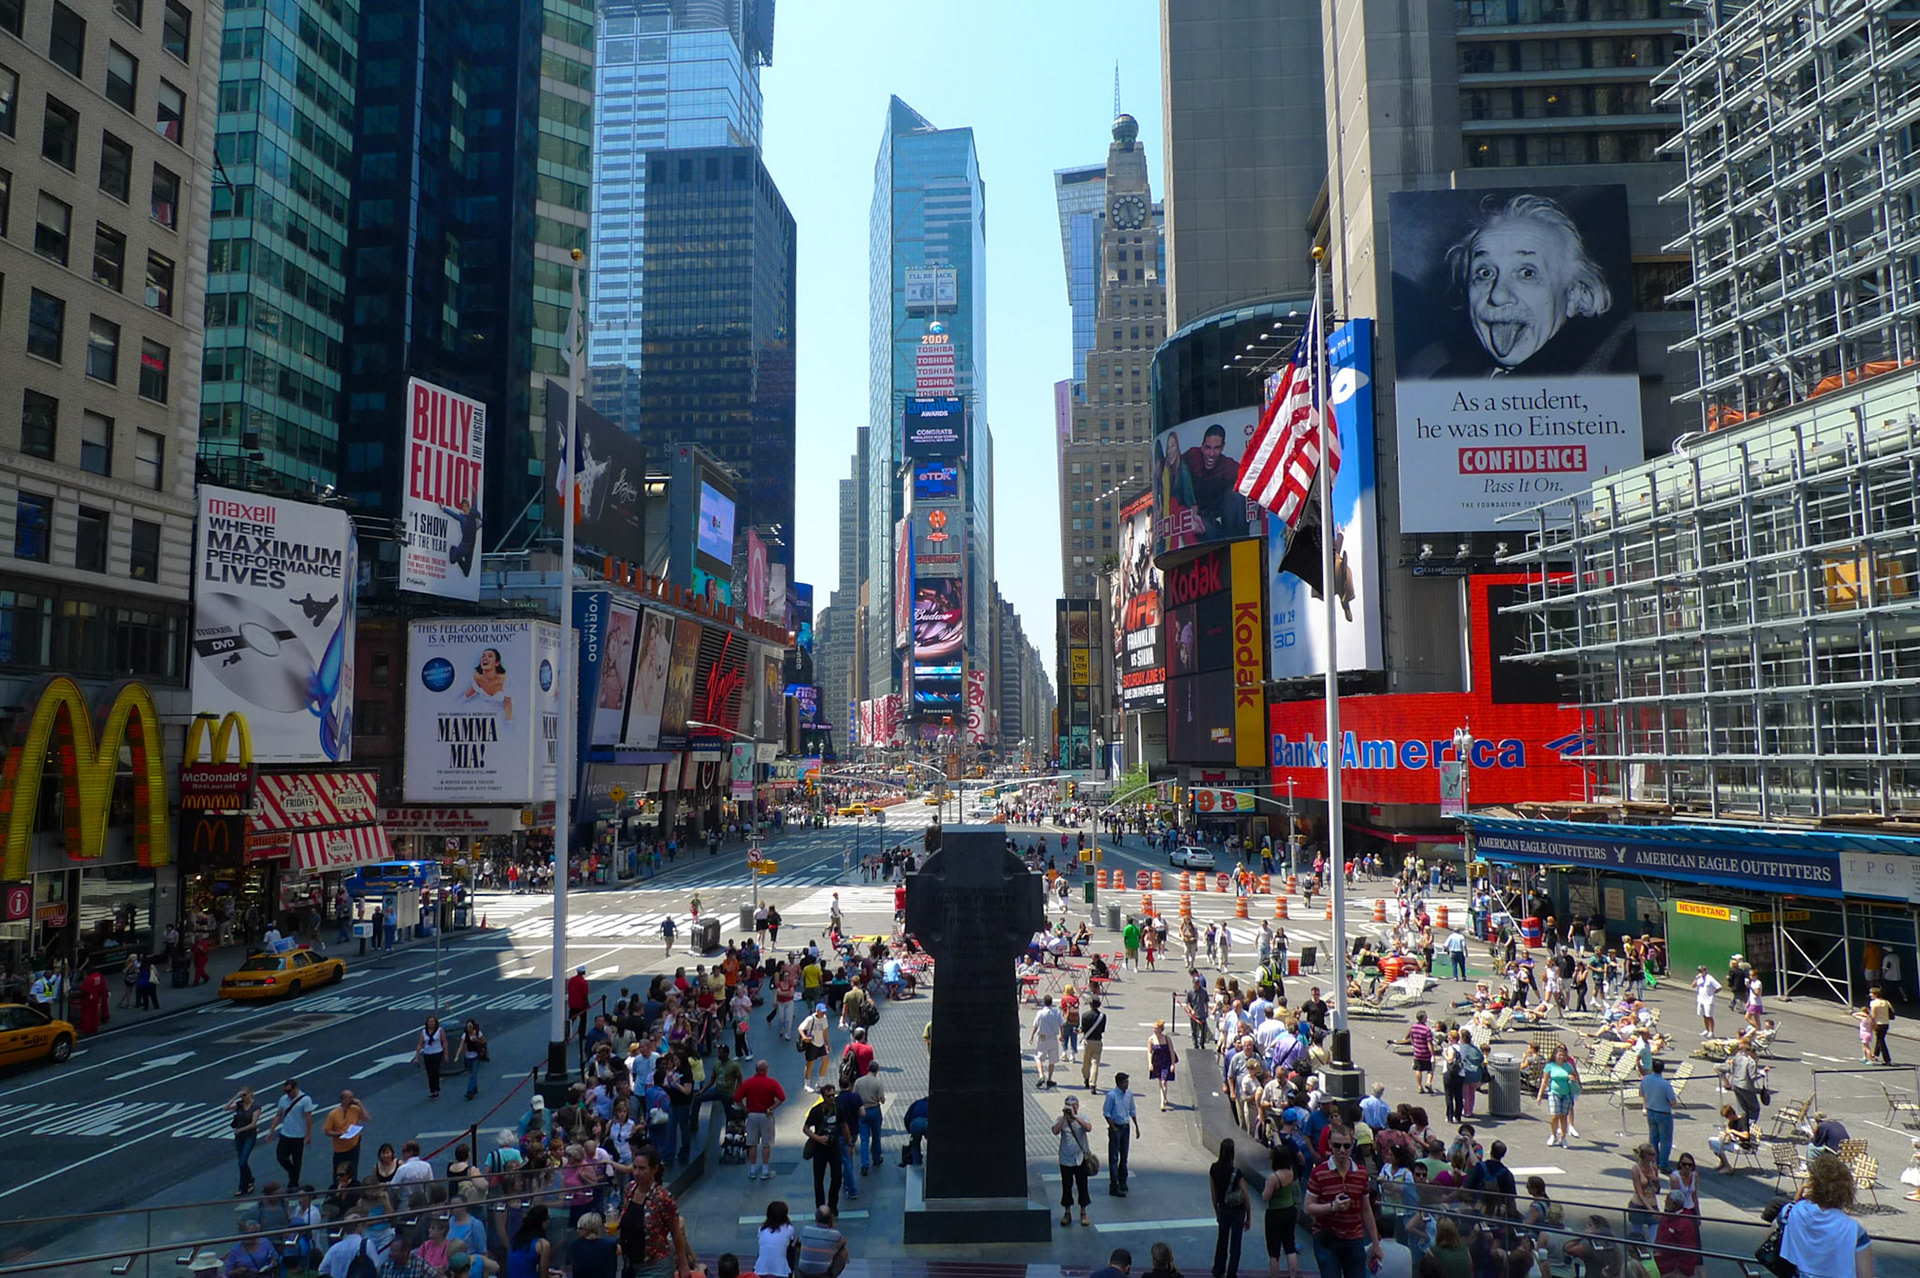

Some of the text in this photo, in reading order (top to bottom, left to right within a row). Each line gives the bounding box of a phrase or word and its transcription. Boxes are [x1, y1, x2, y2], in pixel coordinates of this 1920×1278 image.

[922, 335, 948, 344] 2009
[918, 356, 954, 364] TOSHIBA
[1452, 389, 1588, 412] As a student,
[413, 384, 473, 456] BILLY
[473, 407, 484, 444] MUSICAL
[1416, 414, 1626, 439] he was no Einstein.
[472, 445, 482, 460] THE
[1462, 449, 1584, 472] CONFIDENCE
[410, 442, 482, 511] ELLIOT
[927, 472, 951, 480] TDK
[1484, 476, 1564, 494] Pass It On.
[208, 498, 276, 524] maxell
[209, 517, 275, 539] WHERE
[420, 514, 448, 538] SHOW
[208, 530, 342, 566] MAXIMUM
[408, 532, 447, 553] OF THE YEAR
[206, 549, 342, 578] PERFORMANCE
[916, 555, 960, 564] CHEVROLET
[205, 562, 286, 590] LIVES
[1168, 552, 1222, 606] Kodak
[1126, 591, 1158, 632] UFC
[1274, 610, 1296, 626] MAY 29
[196, 626, 233, 636] maxell
[414, 622, 530, 634] "THIS FEEL-GOOD MUSICAL
[588, 594, 598, 663] VORNADO
[212, 639, 235, 650] DVD
[428, 635, 436, 644] IS
[438, 635, 446, 644] A
[1127, 627, 1156, 652] FRANKLIN
[1274, 632, 1296, 649] 3D
[1138, 647, 1154, 668] SILVA
[1235, 602, 1260, 708] Kodak
[1073, 662, 1087, 672] LION
[1073, 672, 1088, 680] KING
[1146, 669, 1158, 684] JUNE
[1159, 667, 1166, 682] 13
[437, 718, 498, 742] MAMMA
[450, 743, 486, 768] MIA!
[1273, 733, 1319, 768] Bank
[182, 772, 247, 782] McDonald's
[285, 798, 314, 810] FRIDAY'S
[338, 796, 362, 806] FRIDAY'S
[387, 809, 474, 820] DIGITAL
[1478, 836, 1606, 860] AMERICAN EAGLE OUTFITTERS
[1636, 850, 1832, 882] AMERICAN EAGLE OUTFITTERS
[1680, 903, 1727, 918] NEWSSTAND
[30, 1102, 207, 1136] ONLY
